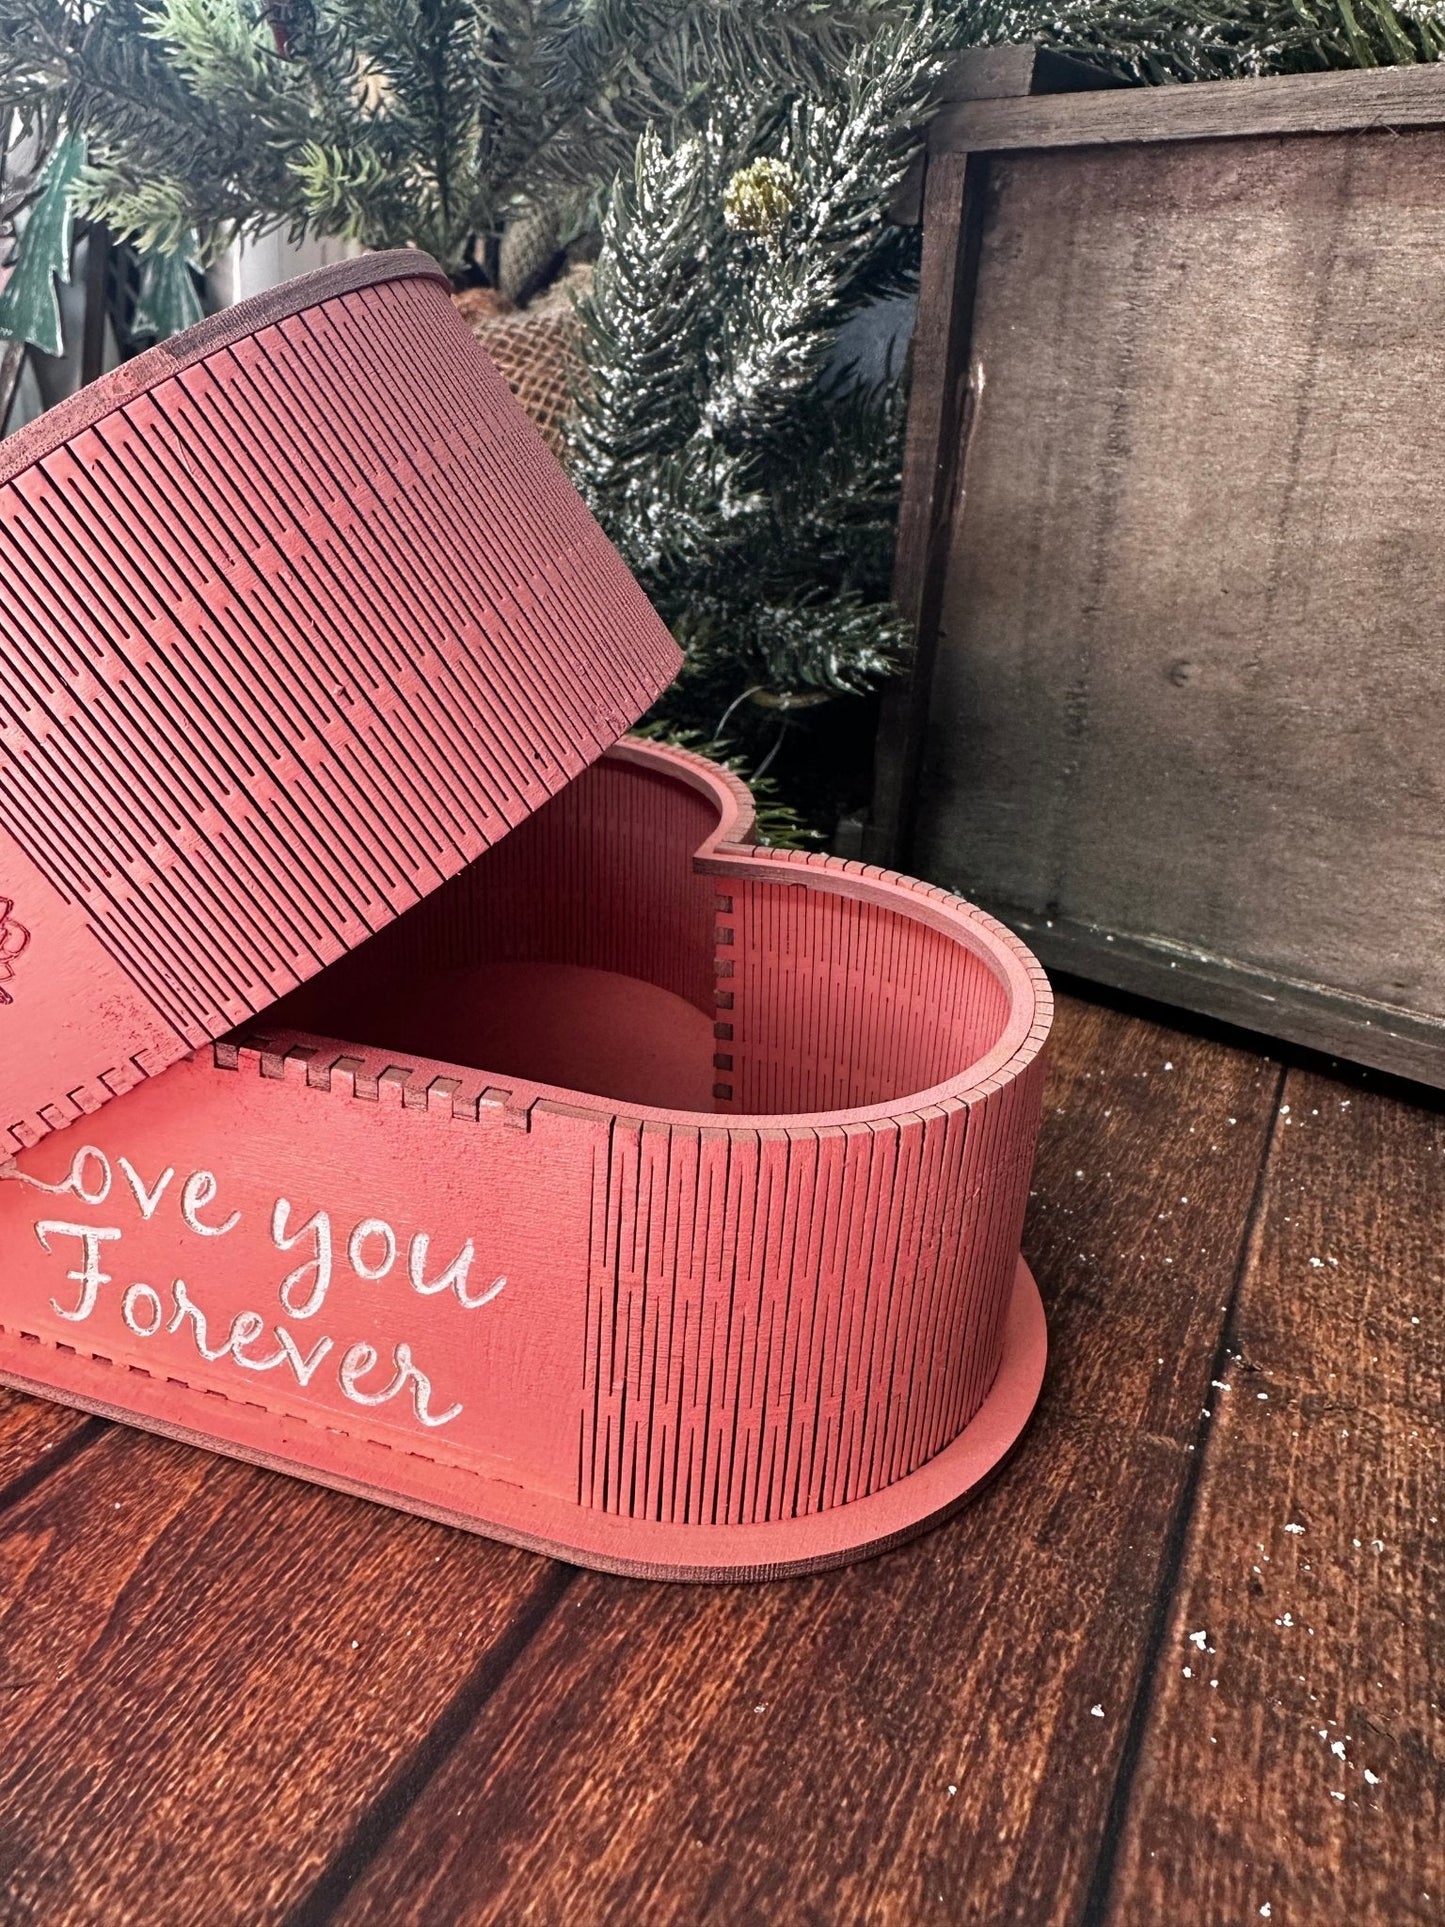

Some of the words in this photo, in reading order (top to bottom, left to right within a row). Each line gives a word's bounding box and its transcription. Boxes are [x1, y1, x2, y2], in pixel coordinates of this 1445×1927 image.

[0, 1145, 241, 1236] ove
[271, 1198, 507, 1318] you
[34, 1220, 463, 1427] Forever
